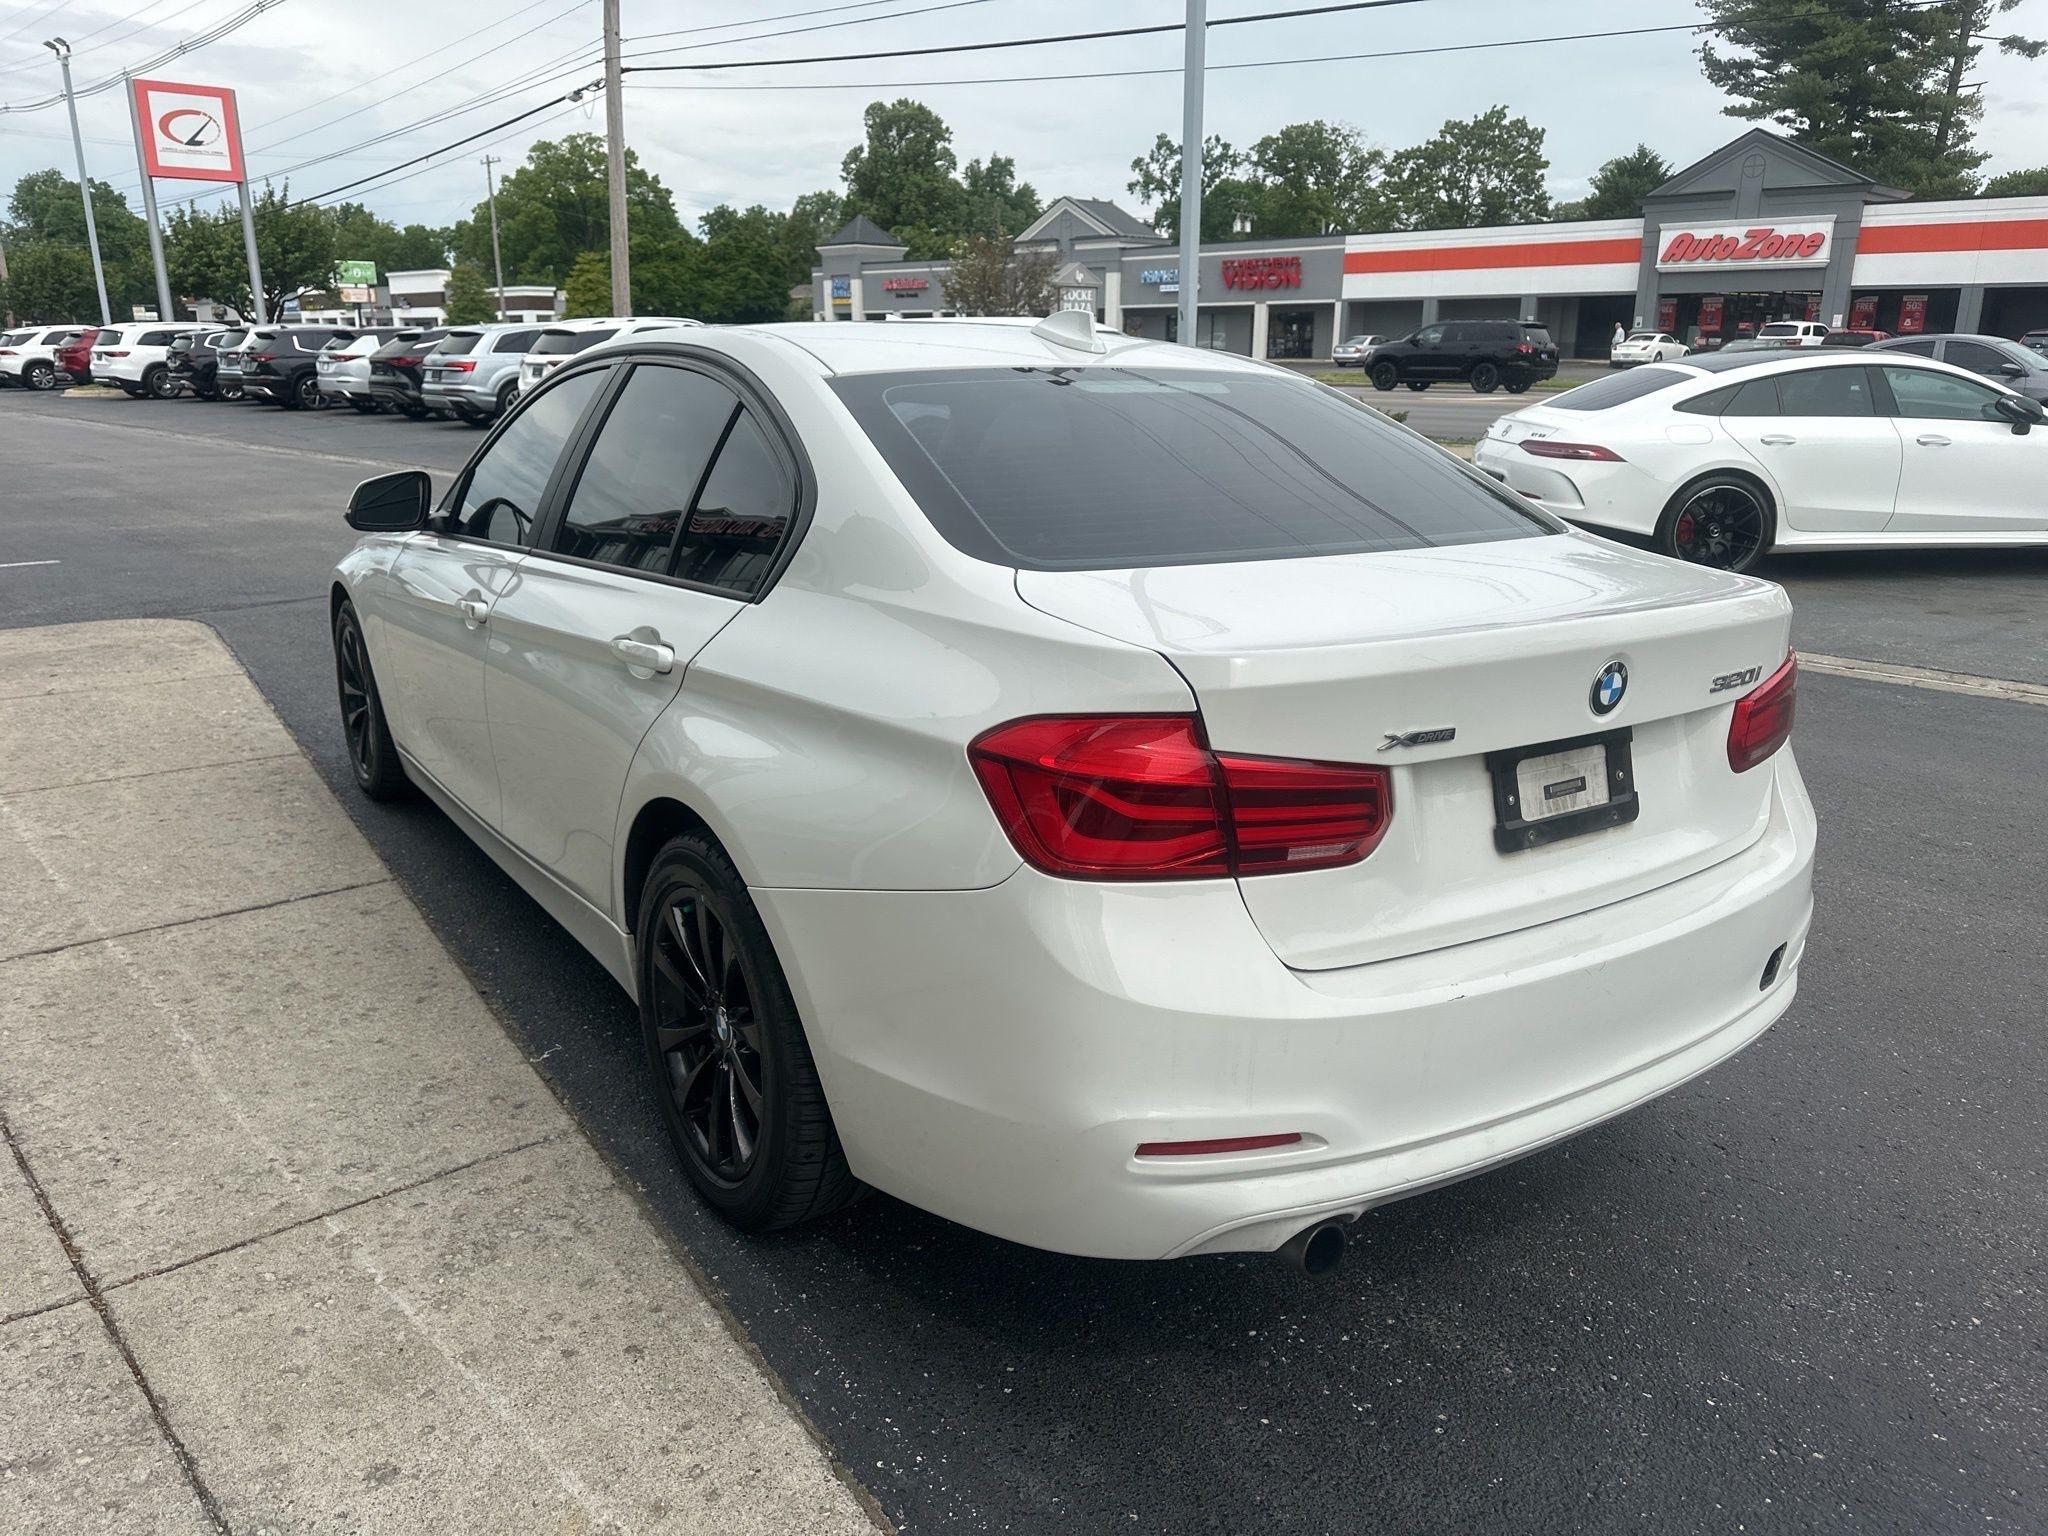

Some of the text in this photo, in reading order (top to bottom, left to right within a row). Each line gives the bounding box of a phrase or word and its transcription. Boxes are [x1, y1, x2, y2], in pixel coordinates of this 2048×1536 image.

[1660, 228, 1825, 262] AutoZone
[1222, 269, 1302, 290] VISION
[1855, 301, 1875, 310] FREE
